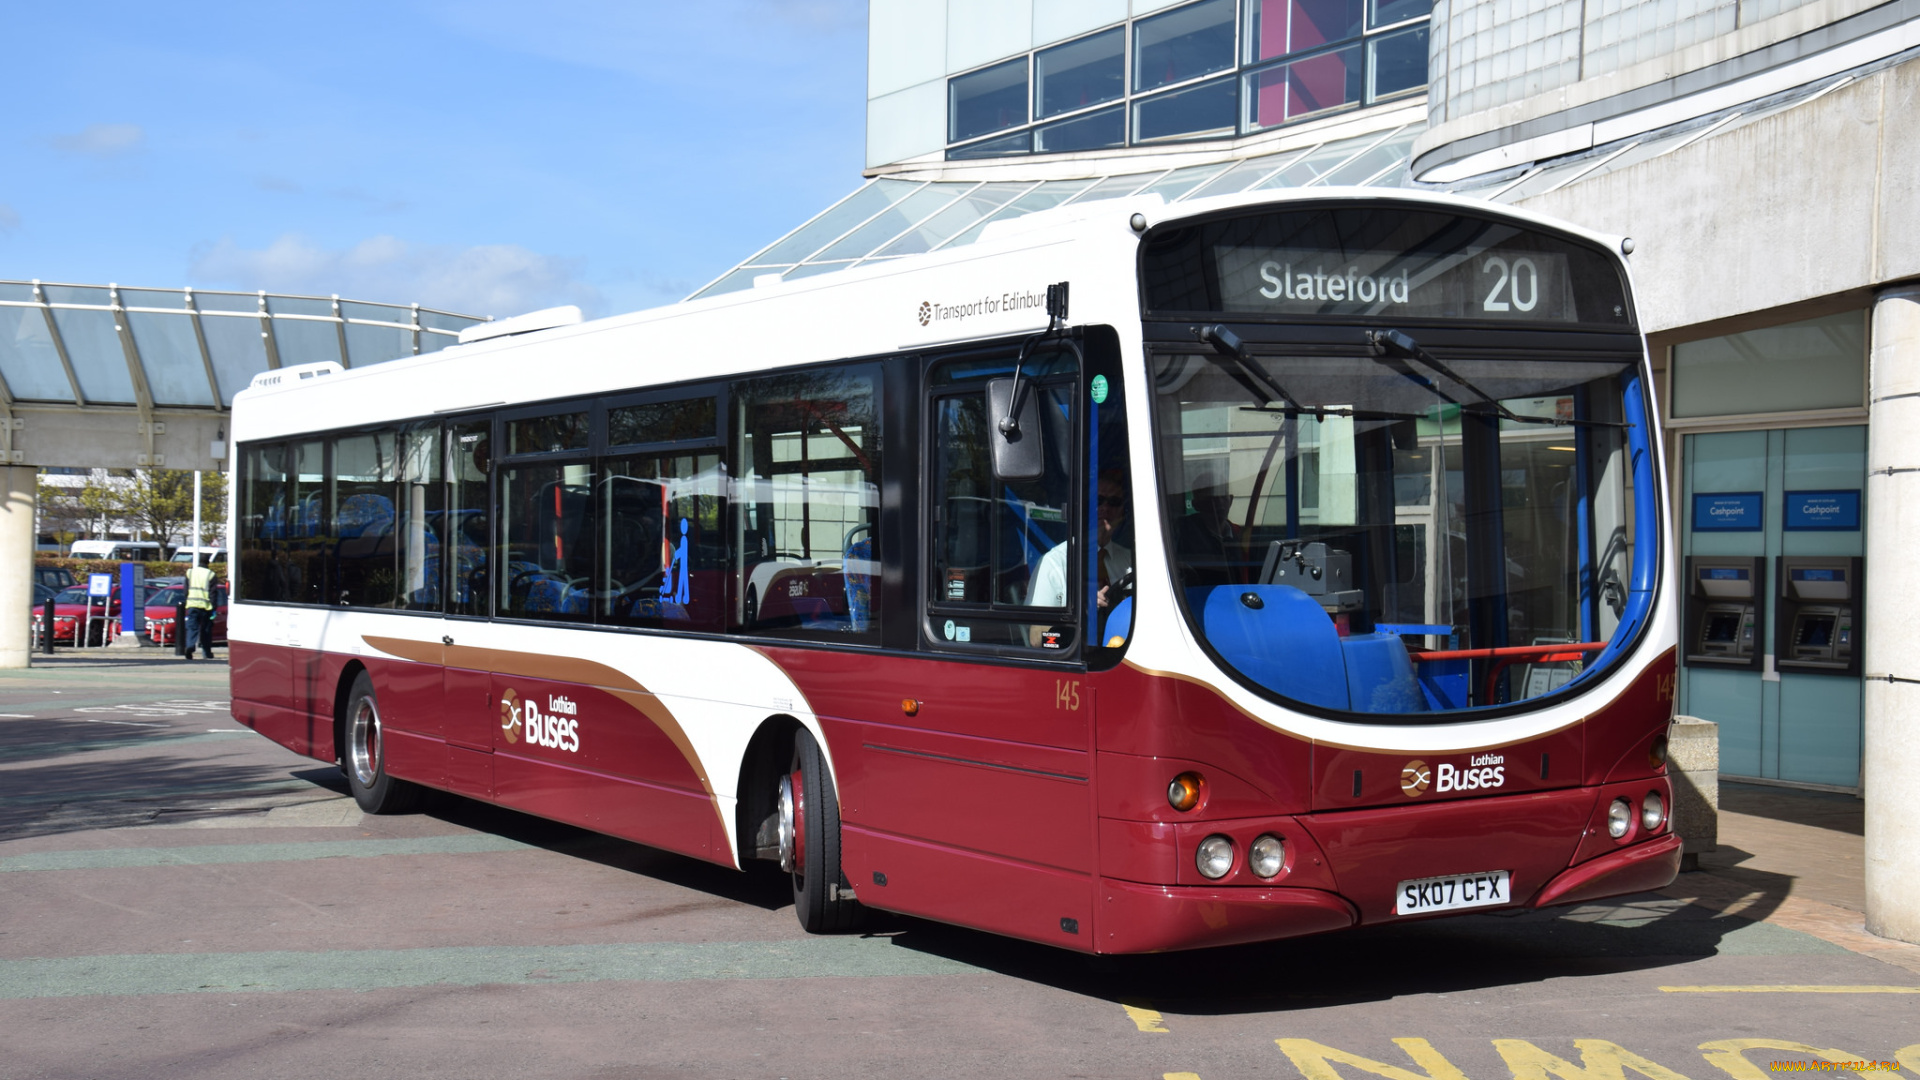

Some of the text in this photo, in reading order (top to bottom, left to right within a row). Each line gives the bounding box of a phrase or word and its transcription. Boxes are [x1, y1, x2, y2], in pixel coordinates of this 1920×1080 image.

[1259, 256, 1538, 313] Slateford 20
[934, 290, 1048, 321] Transport for Edinbur
[1710, 506, 1744, 517] Cashpoint
[1803, 505, 1840, 515] Cashpoint
[549, 694, 577, 715] Lothian
[1056, 679, 1080, 711] 145
[525, 699, 579, 752] Buses
[1471, 753, 1504, 767] Lothian
[1436, 763, 1505, 792] Buses
[1405, 875, 1500, 908] SK07 CFX
